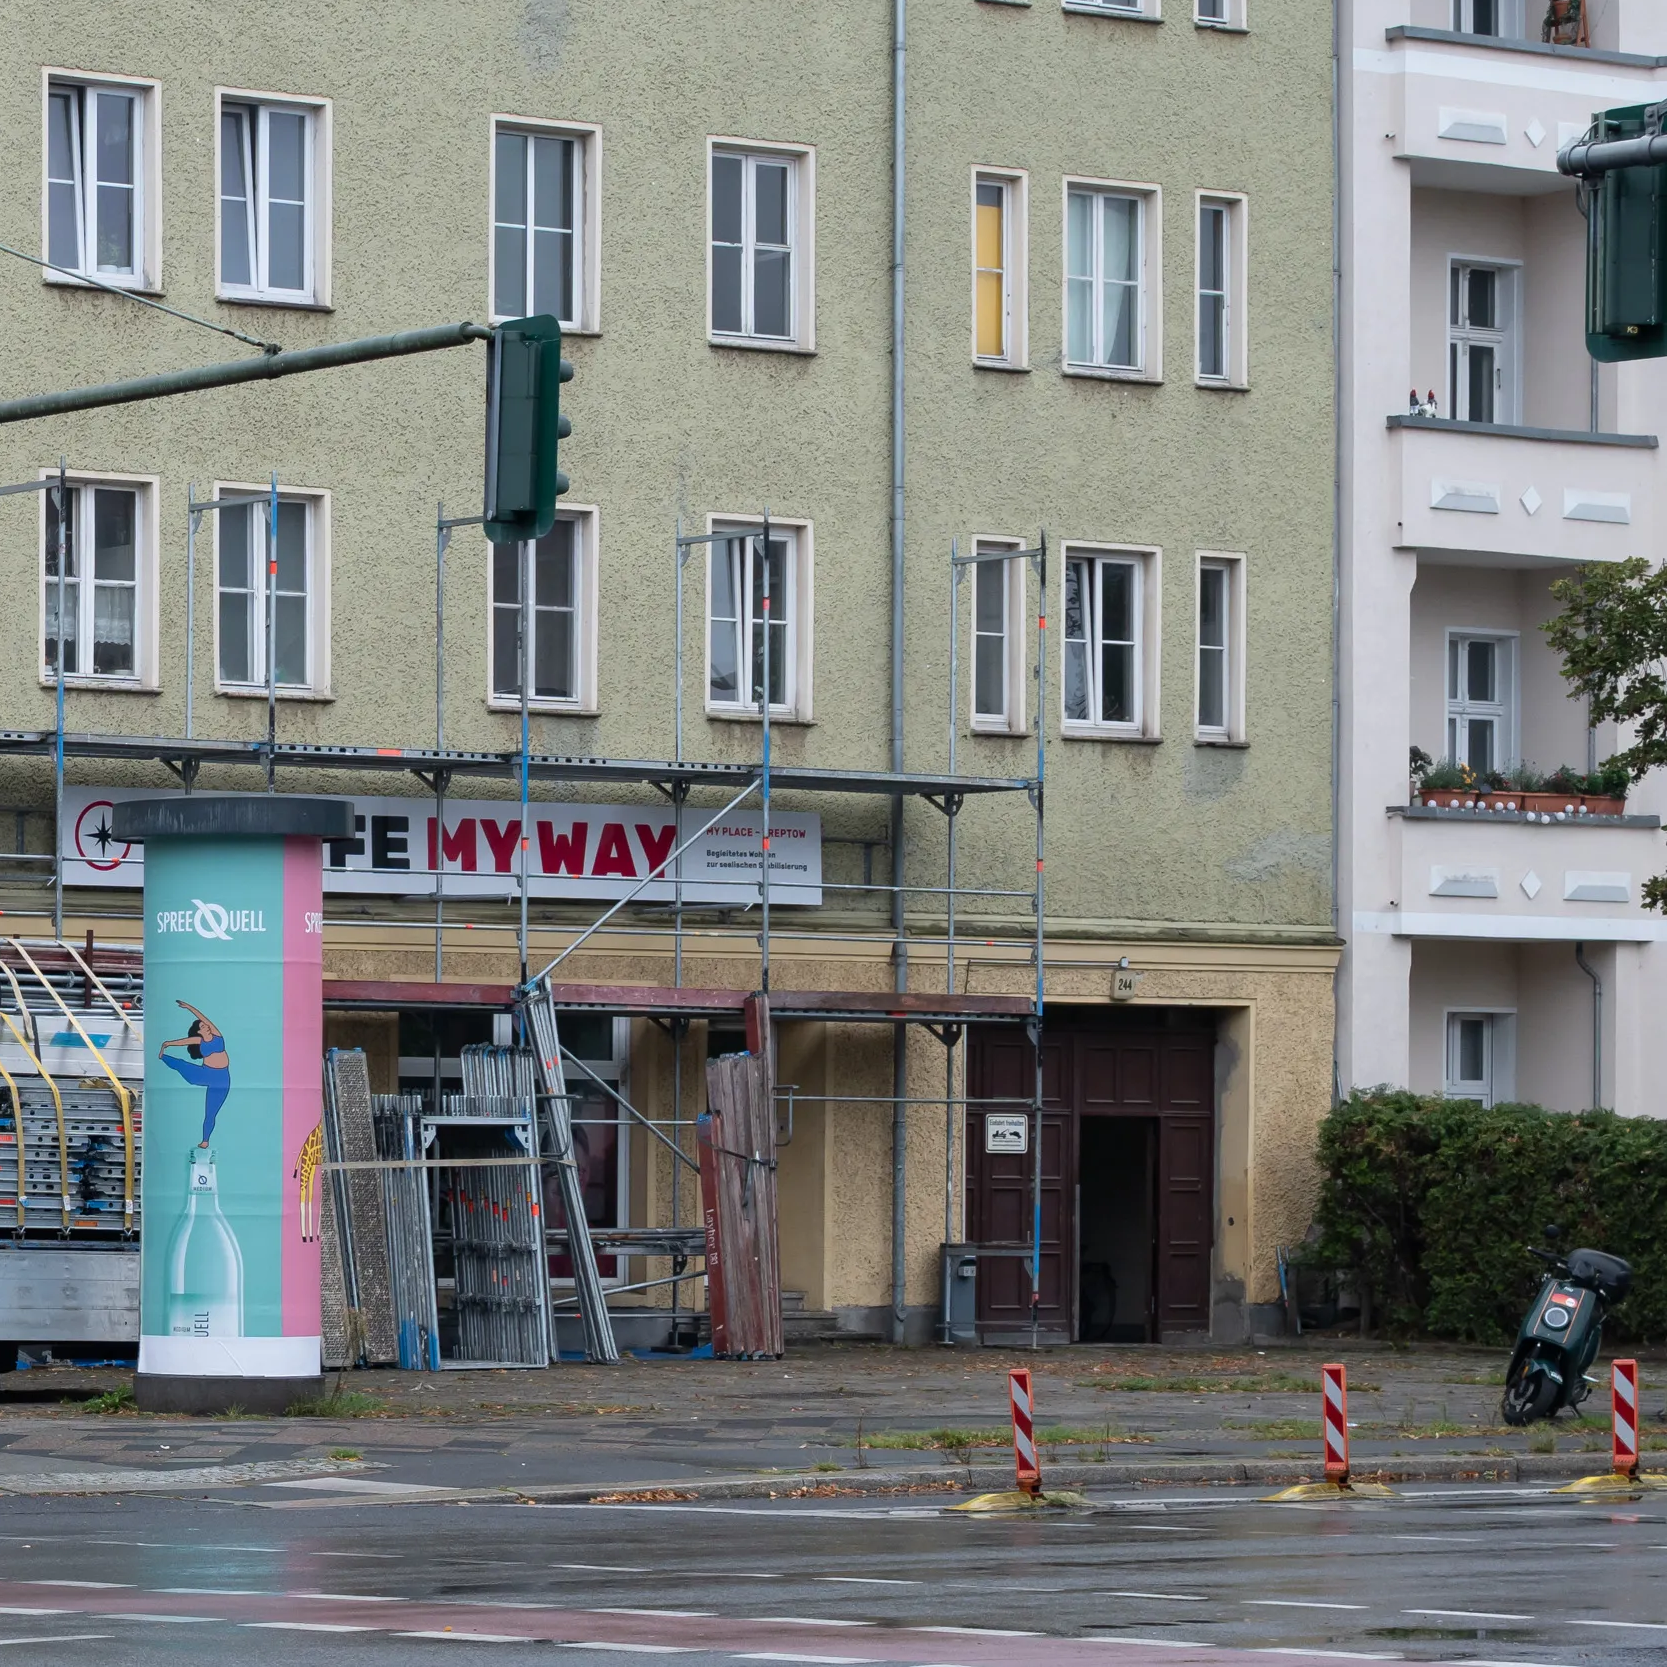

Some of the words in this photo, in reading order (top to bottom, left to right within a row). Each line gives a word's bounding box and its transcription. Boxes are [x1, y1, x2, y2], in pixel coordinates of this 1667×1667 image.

[722, 827, 753, 837] PLACE
[762, 828, 807, 838] REPTOW
[427, 816, 523, 874] MY
[536, 820, 678, 879] WAY
[706, 850, 748, 859] Begleitetes
[749, 851, 776, 859] Wohen
[719, 861, 757, 869] seelischen
[758, 862, 808, 872] Sbilisierung
[1118, 978, 1133, 991] 244
